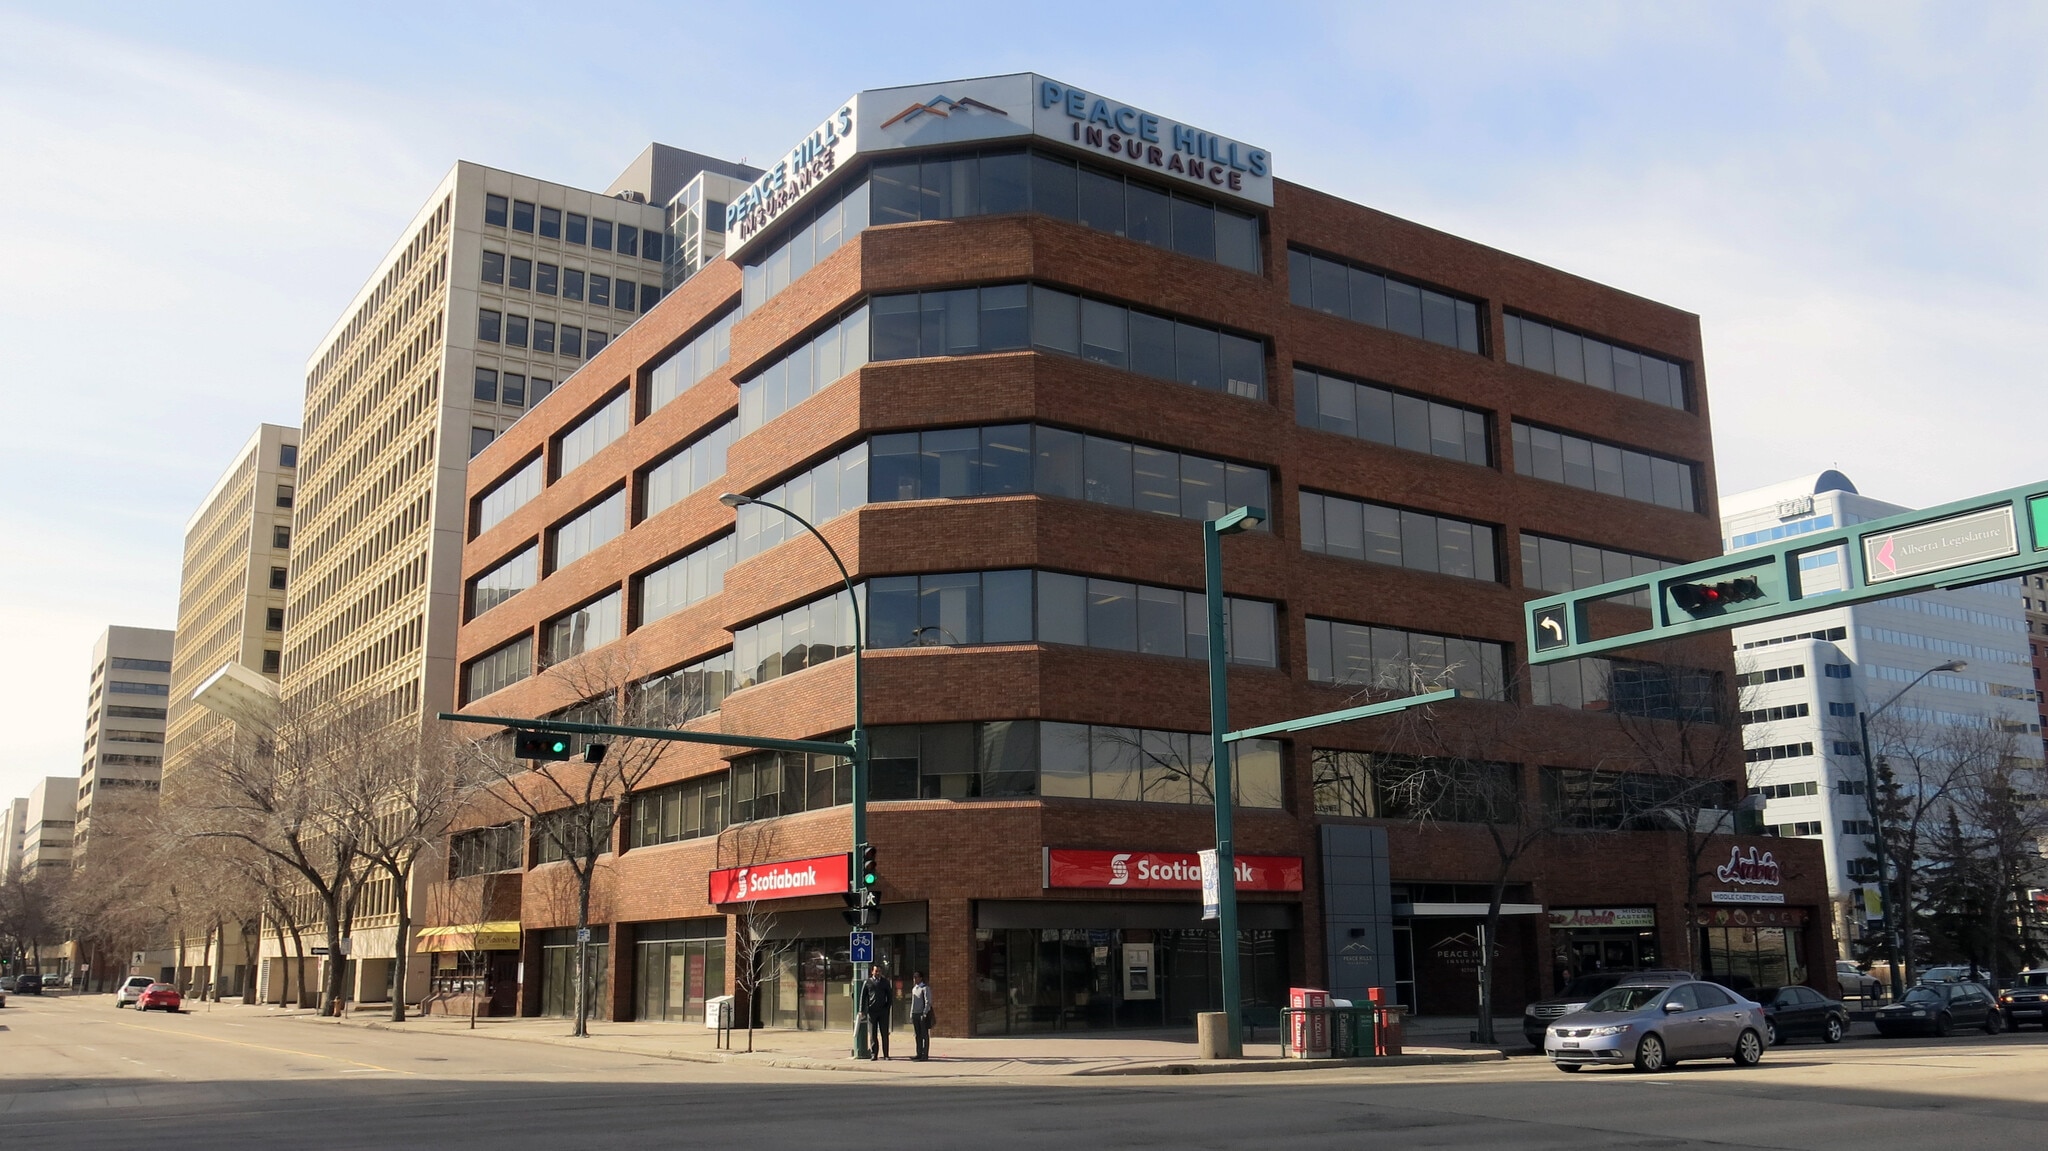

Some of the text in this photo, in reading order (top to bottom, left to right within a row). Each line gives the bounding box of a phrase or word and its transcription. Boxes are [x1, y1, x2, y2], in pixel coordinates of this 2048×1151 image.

[1042, 80, 1267, 177] PEACE HILLS
[725, 106, 852, 232] PEACE HILLS
[1073, 121, 1242, 191] INSURANCE
[740, 148, 835, 241] INSURANCE
[1900, 526, 2001, 557] Alberta Legislature
[750, 866, 817, 892] Scotiabank
[1137, 860, 1254, 882] Scotiank
[1437, 950, 1468, 958] PEACE
